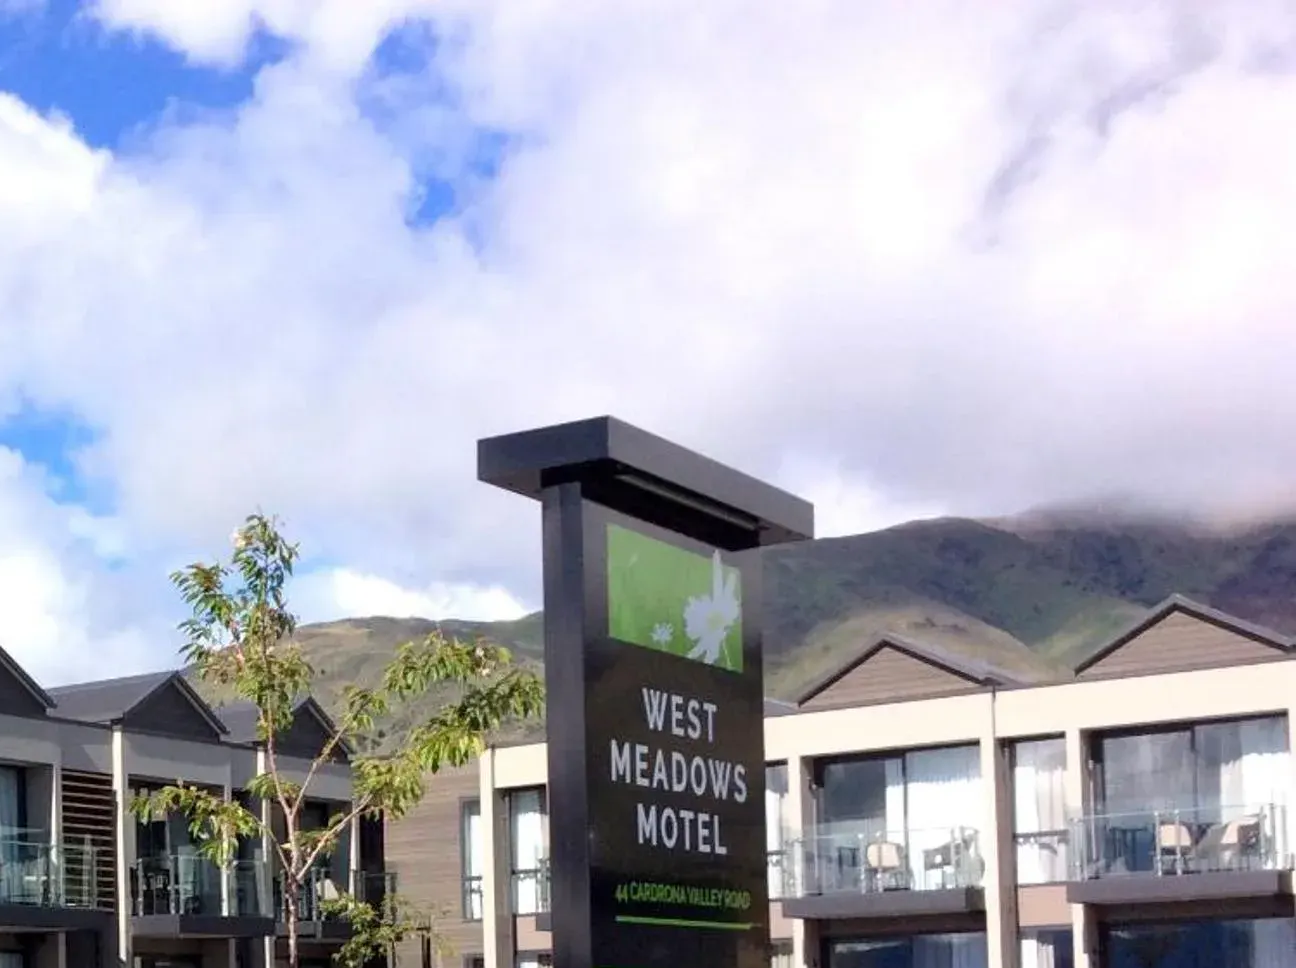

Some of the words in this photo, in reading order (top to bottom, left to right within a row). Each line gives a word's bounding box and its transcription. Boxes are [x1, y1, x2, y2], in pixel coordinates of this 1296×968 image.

[641, 687, 718, 742] WEST
[610, 739, 748, 804] MEADOWS
[636, 802, 727, 855] MOTEL
[615, 884, 628, 903] 44
[687, 886, 722, 907] VALLEY
[724, 889, 751, 910] ROAD
